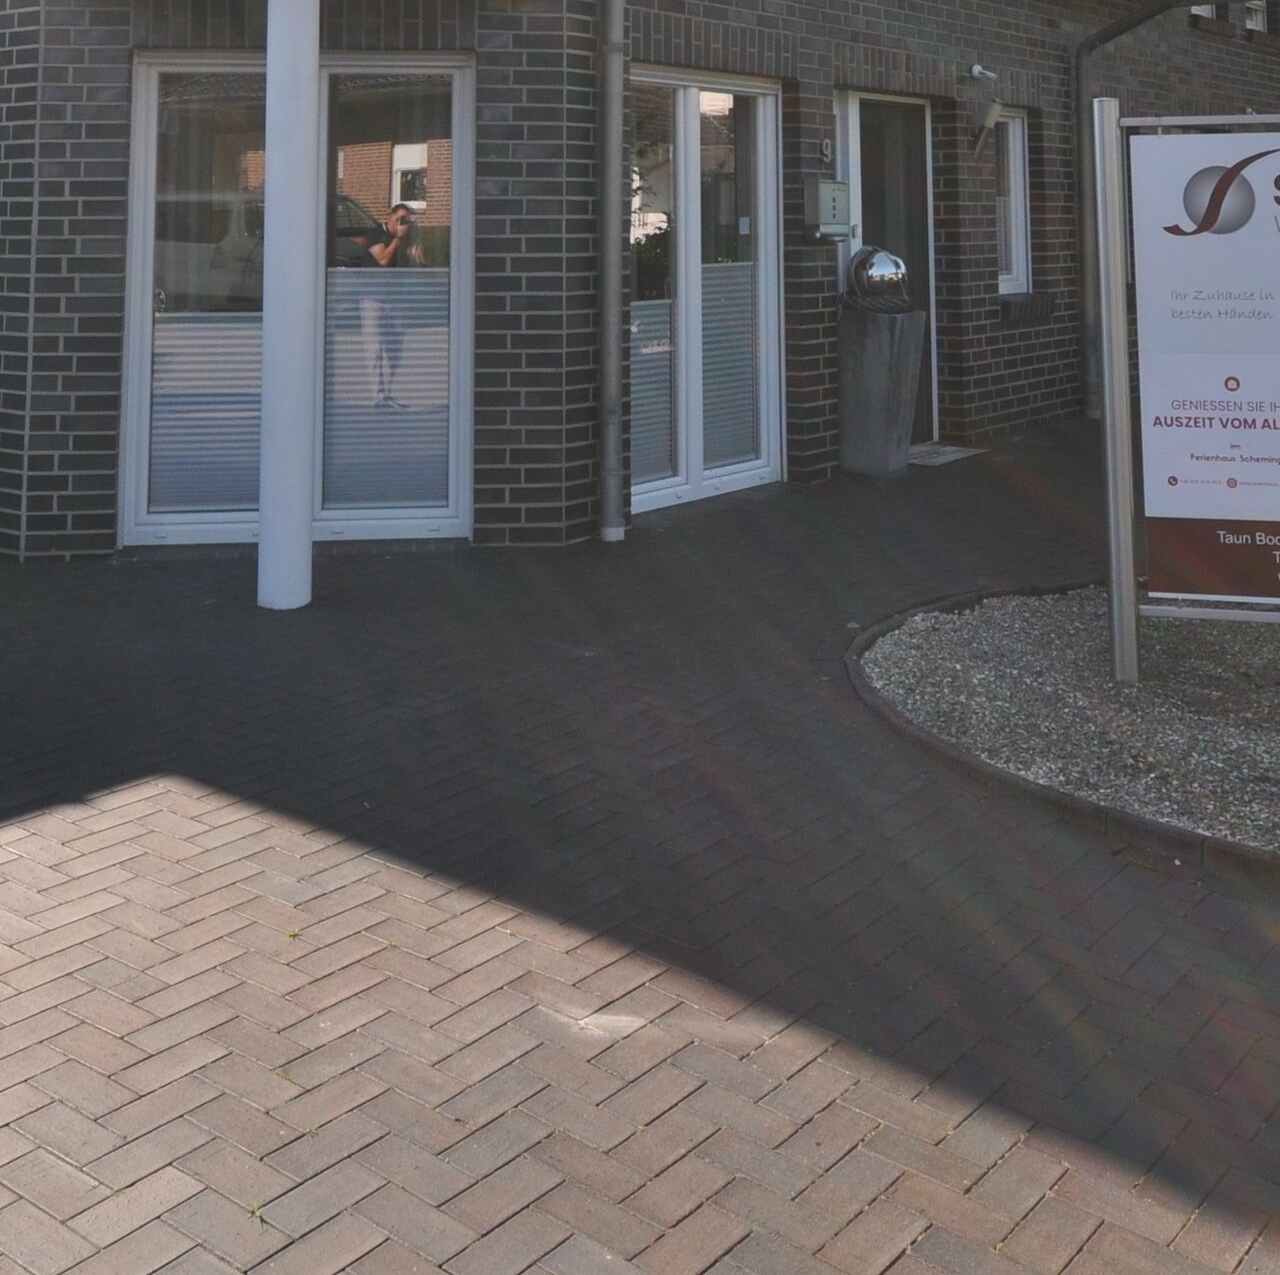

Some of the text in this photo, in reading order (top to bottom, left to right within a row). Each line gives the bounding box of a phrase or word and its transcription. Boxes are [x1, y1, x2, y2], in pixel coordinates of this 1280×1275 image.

[822, 138, 832, 163] 9
[1170, 288, 1275, 301] Ihr Zuhause in
[1171, 308, 1273, 320] besten Händen
[1171, 399, 1244, 412] GENIESSEN
[1247, 400, 1266, 412] SIE
[1152, 415, 1215, 429] AUSZEIT
[1219, 417, 1257, 430] VOM
[1189, 453, 1236, 463] Ferienhaus
[1216, 530, 1251, 544] Taun
